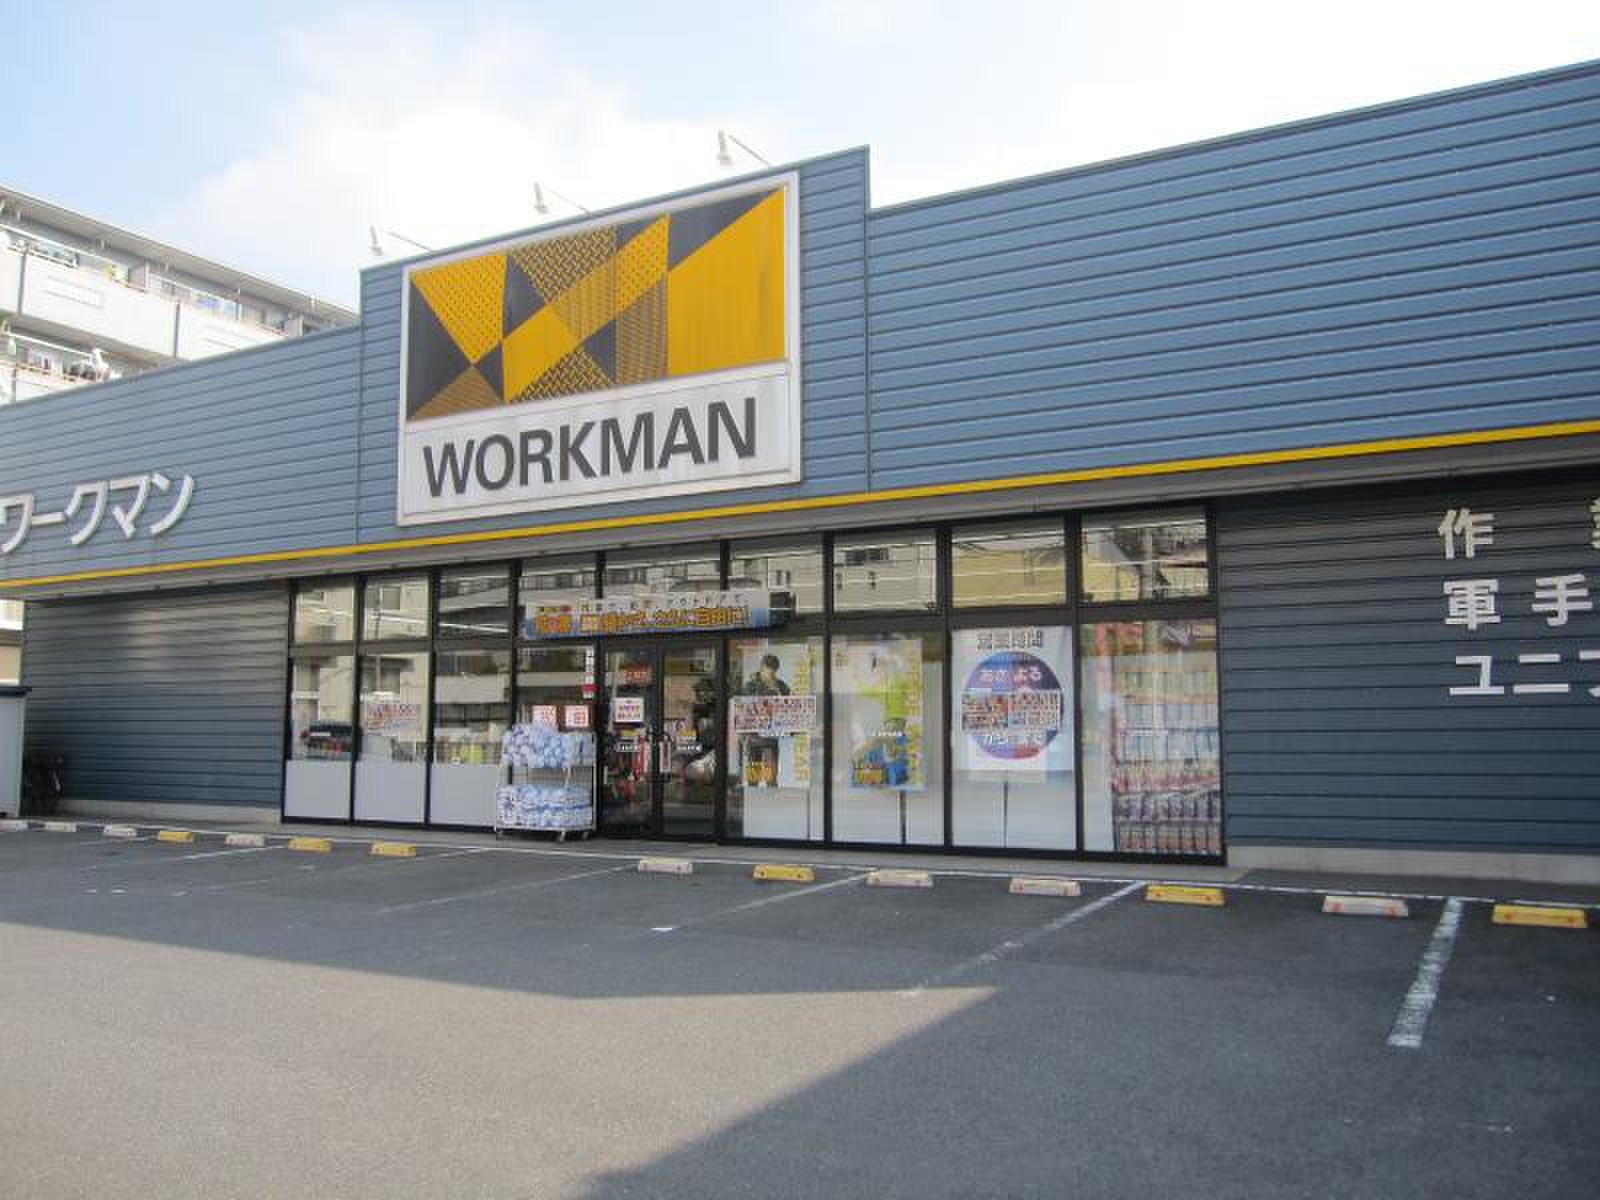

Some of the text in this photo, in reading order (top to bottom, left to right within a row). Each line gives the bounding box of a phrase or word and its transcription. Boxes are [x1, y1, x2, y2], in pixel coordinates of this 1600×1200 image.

[423, 397, 757, 498] WORKMAN
[0, 472, 194, 554] ワークマン
[1443, 573, 1594, 631] 軍手
